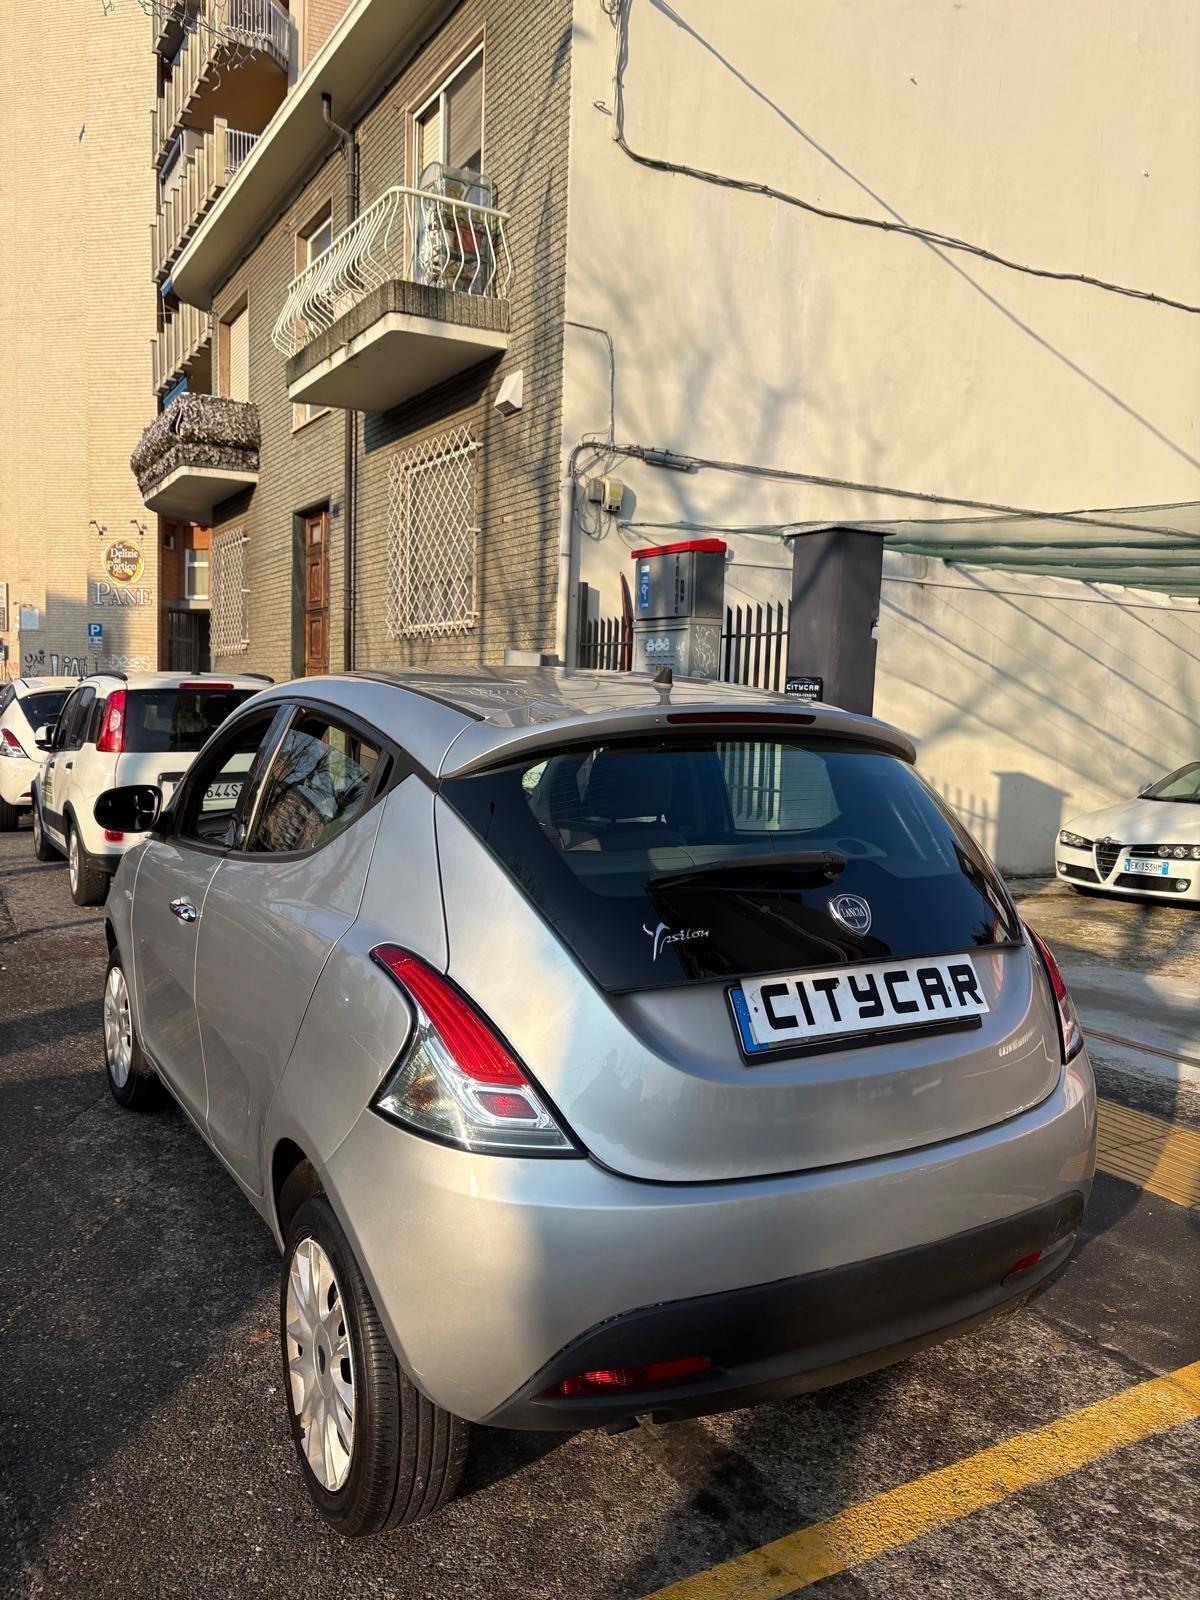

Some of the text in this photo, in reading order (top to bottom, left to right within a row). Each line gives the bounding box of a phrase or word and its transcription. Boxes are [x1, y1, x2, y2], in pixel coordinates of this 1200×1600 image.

[110, 548, 138, 558] Delizie
[107, 561, 137, 571] Portico
[92, 582, 152, 606] PANE
[91, 625, 100, 635] P
[206, 783, 243, 798] 644S
[840, 907, 865, 917] LANCIA
[643, 922, 709, 962] Ypsilon
[760, 964, 984, 1030] CITYCAR
